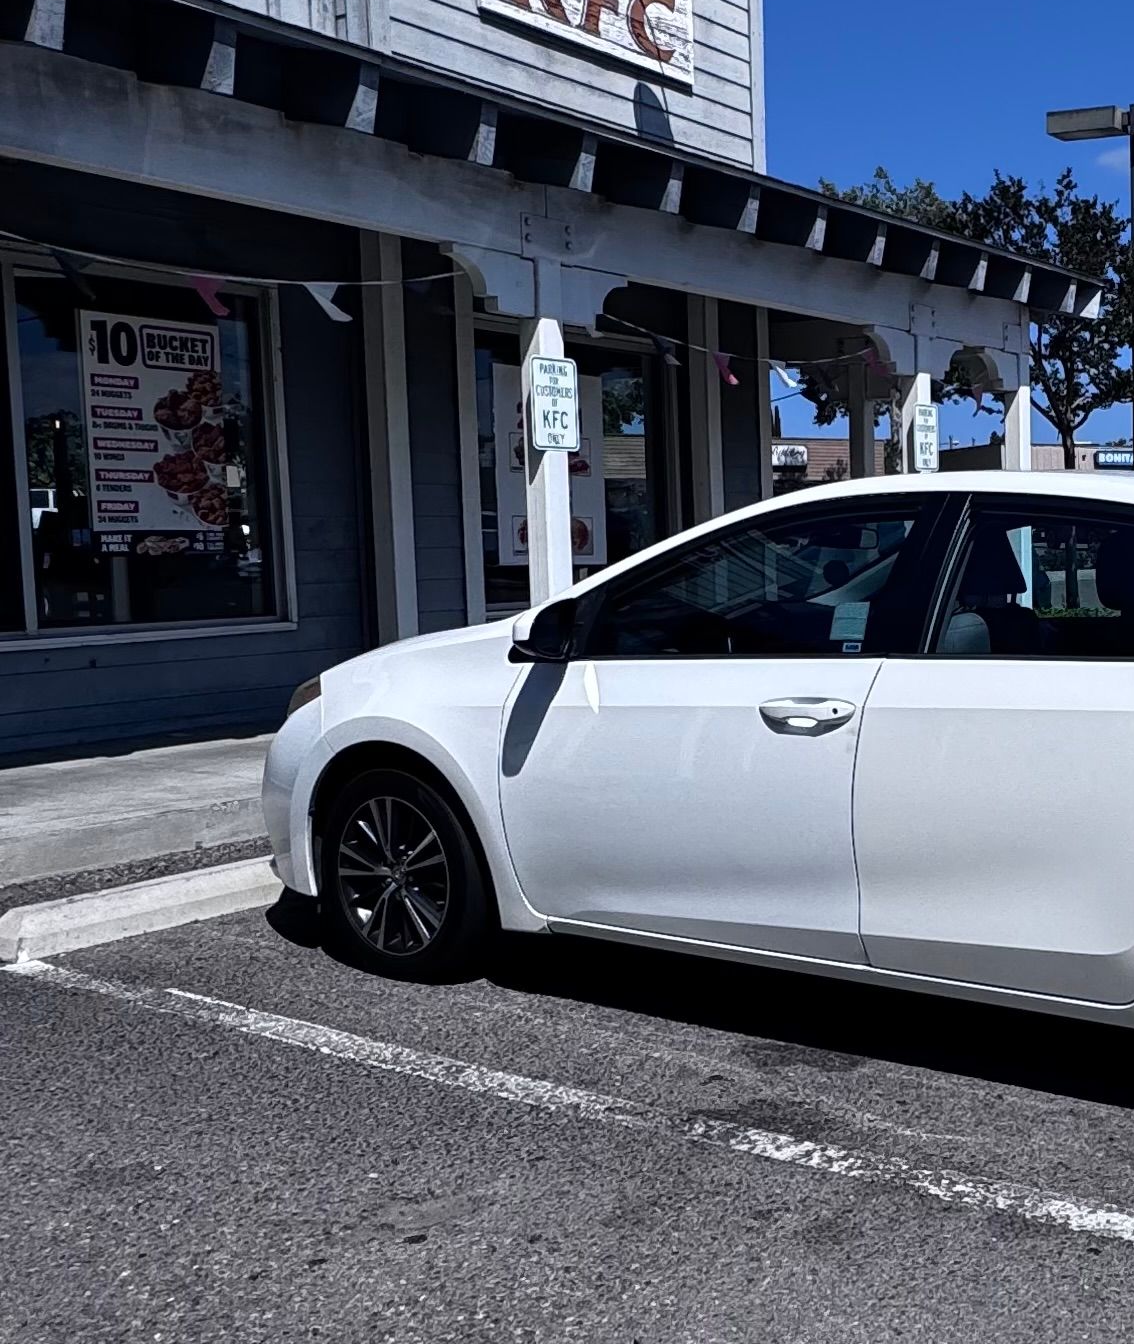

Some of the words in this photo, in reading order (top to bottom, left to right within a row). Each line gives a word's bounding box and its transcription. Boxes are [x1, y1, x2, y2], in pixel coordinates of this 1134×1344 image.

[88, 319, 138, 366] $10
[145, 332, 209, 354] BUCKET
[147, 350, 161, 362] OF
[164, 351, 185, 365] THE
[188, 354, 209, 367] DAY
[539, 362, 568, 377] PARKING
[93, 375, 136, 388] MONDAY
[93, 407, 139, 419] TUESDAY
[542, 409, 569, 430] KFC
[96, 439, 156, 451] WEDNESDAY
[919, 441, 934, 456] KFC
[98, 470, 151, 481] THURSDAY
[100, 502, 136, 511] FRIDAY
